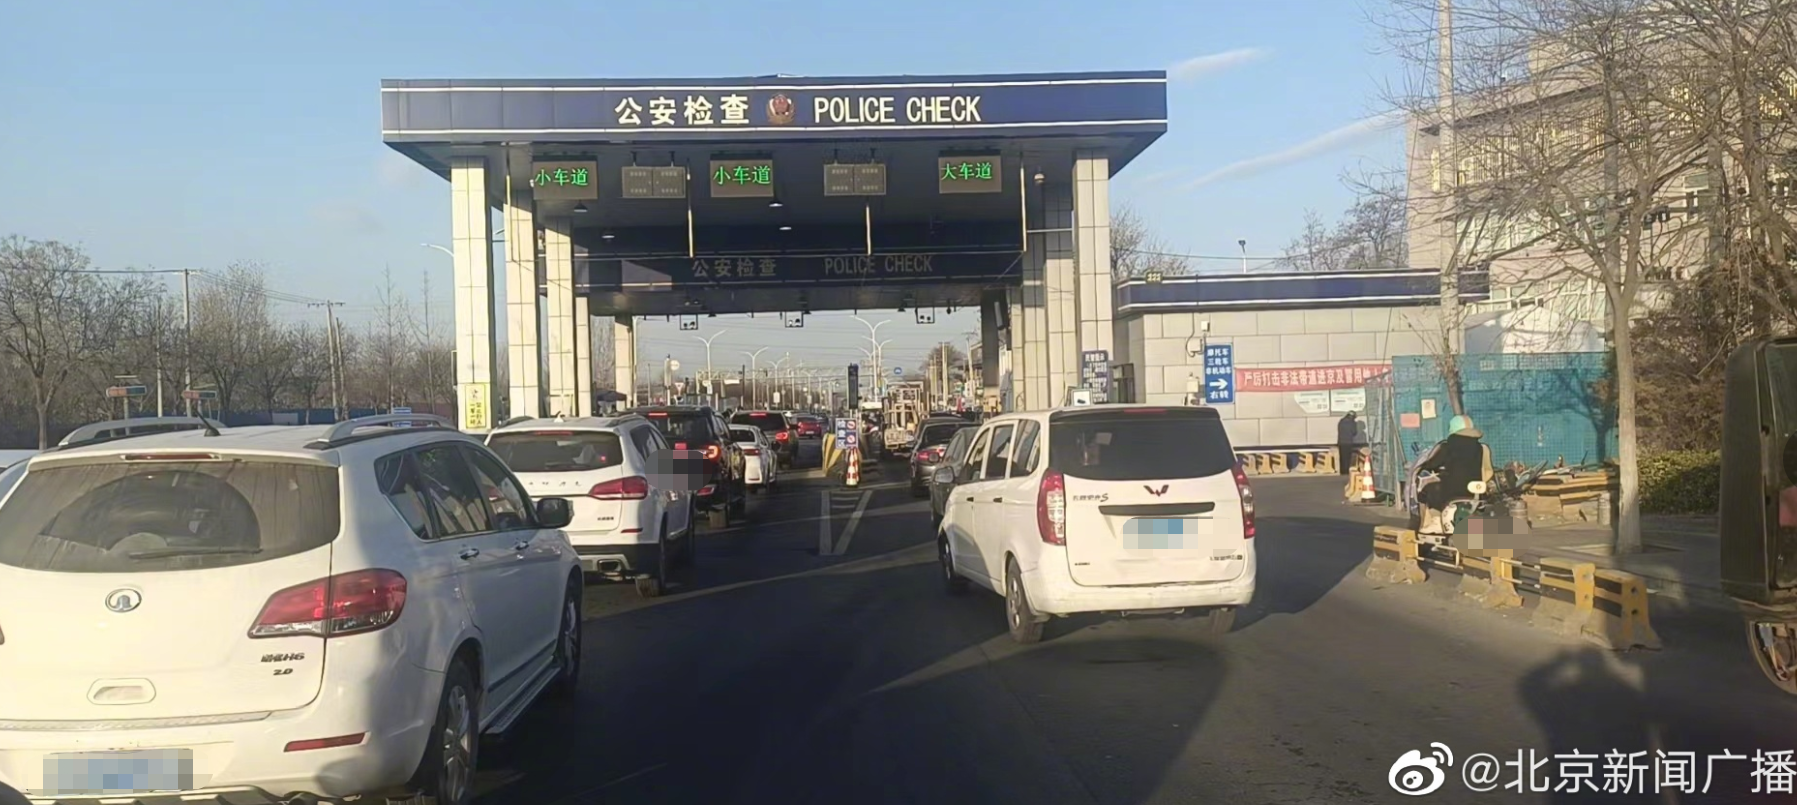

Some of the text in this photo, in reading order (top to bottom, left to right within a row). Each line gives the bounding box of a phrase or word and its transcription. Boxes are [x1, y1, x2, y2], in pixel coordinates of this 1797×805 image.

[614, 94, 750, 126] 公安检查
[814, 95, 981, 123] POLICE CHECK
[534, 168, 589, 187] 小车道
[713, 165, 771, 185] 小车道
[940, 162, 993, 180] 大车道
[692, 258, 777, 278] 公安检查
[825, 255, 932, 275] POLICE CHECK
